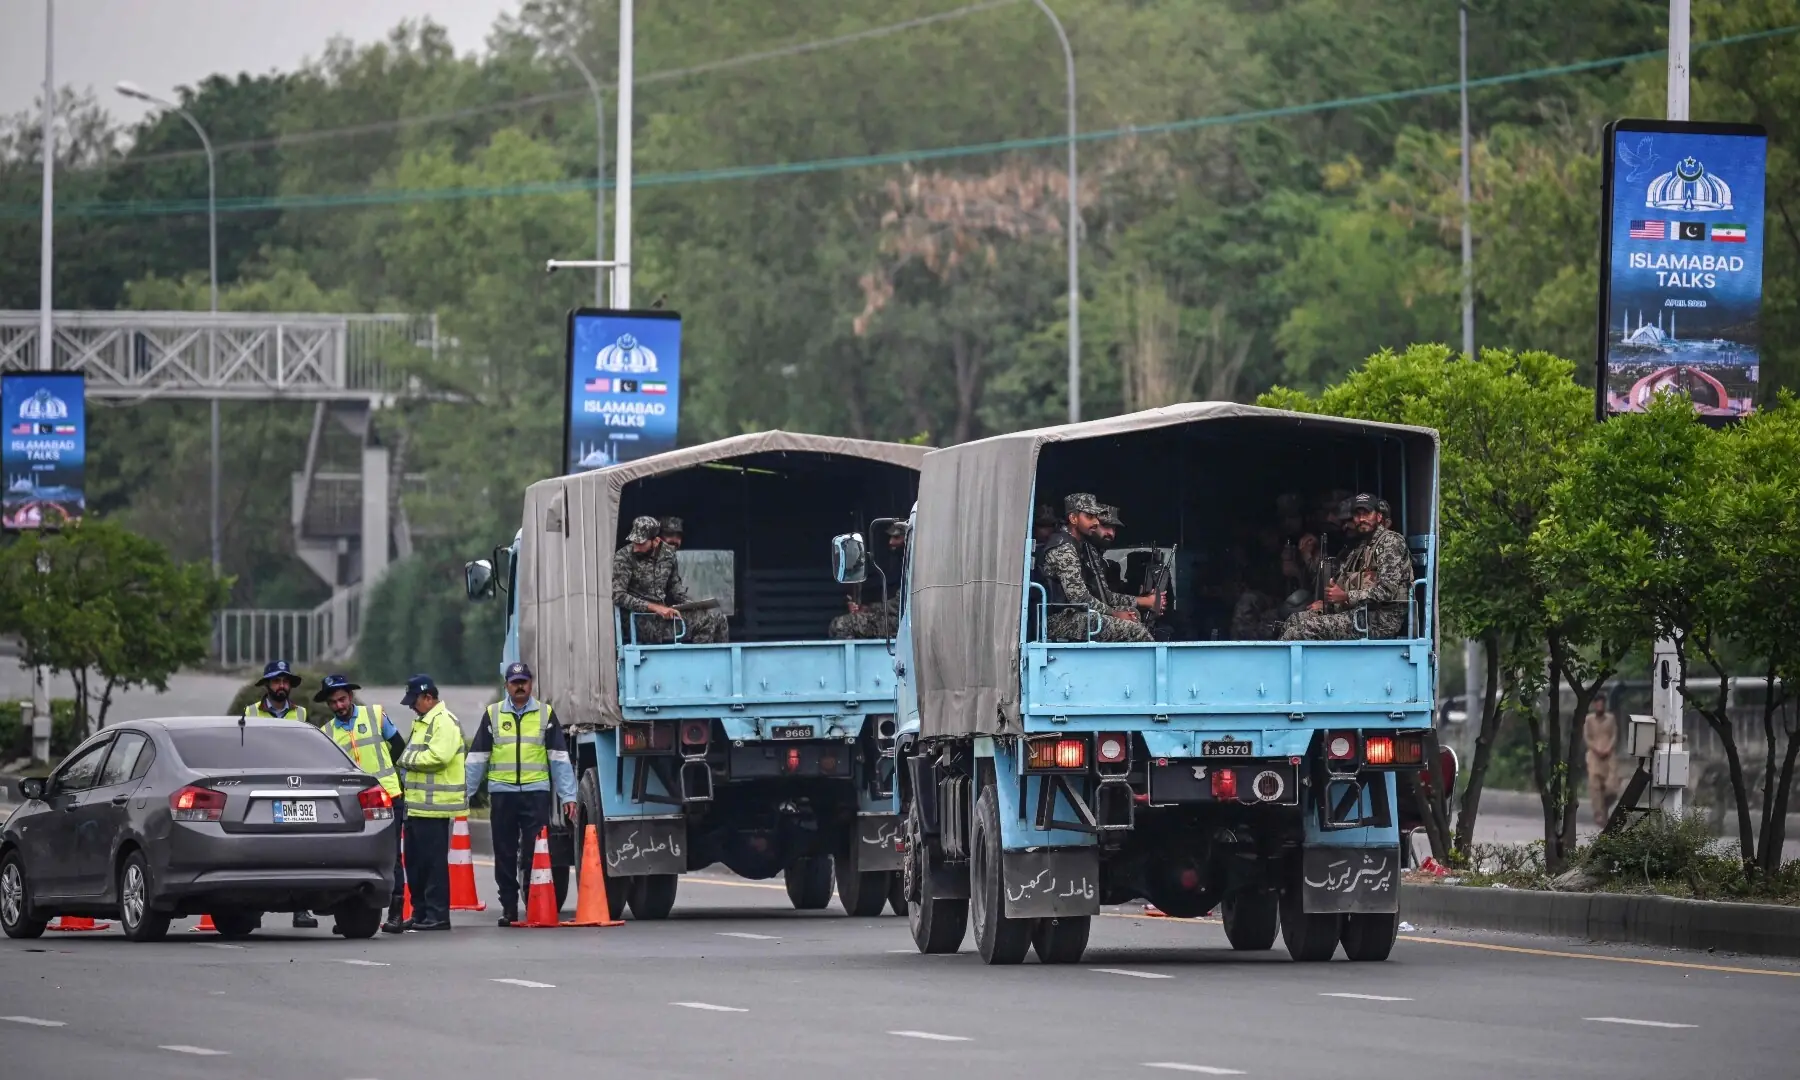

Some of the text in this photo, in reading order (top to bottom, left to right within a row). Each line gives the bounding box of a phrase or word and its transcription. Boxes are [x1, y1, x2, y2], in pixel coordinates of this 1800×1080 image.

[1629, 252, 1744, 272] ISLAMABAD
[1656, 271, 1716, 289] TALKS
[1664, 299, 1687, 307] APRIL
[584, 400, 666, 416] ISLAMABAD
[603, 413, 646, 428] TALKS
[11, 440, 75, 451] ISLAMABAD
[27, 451, 60, 461] TALKS
[785, 729, 811, 738] 9669
[1218, 745, 1249, 755] 9670
